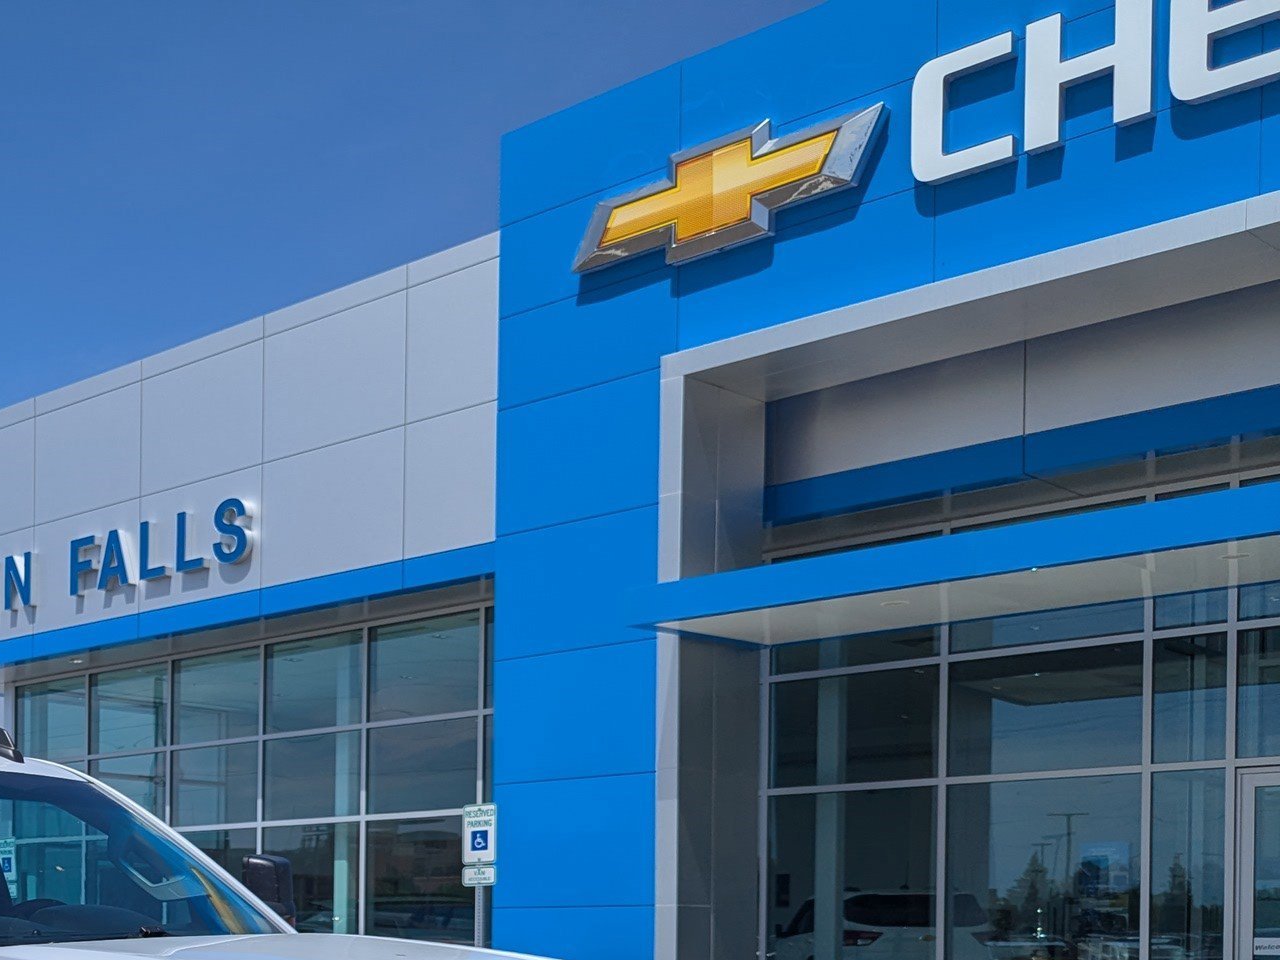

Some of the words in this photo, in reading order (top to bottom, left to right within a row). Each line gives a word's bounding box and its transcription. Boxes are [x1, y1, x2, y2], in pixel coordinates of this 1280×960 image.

[69, 497, 253, 597] FALLS
[465, 808, 495, 819] RESERVED
[466, 819, 493, 828] PARKING
